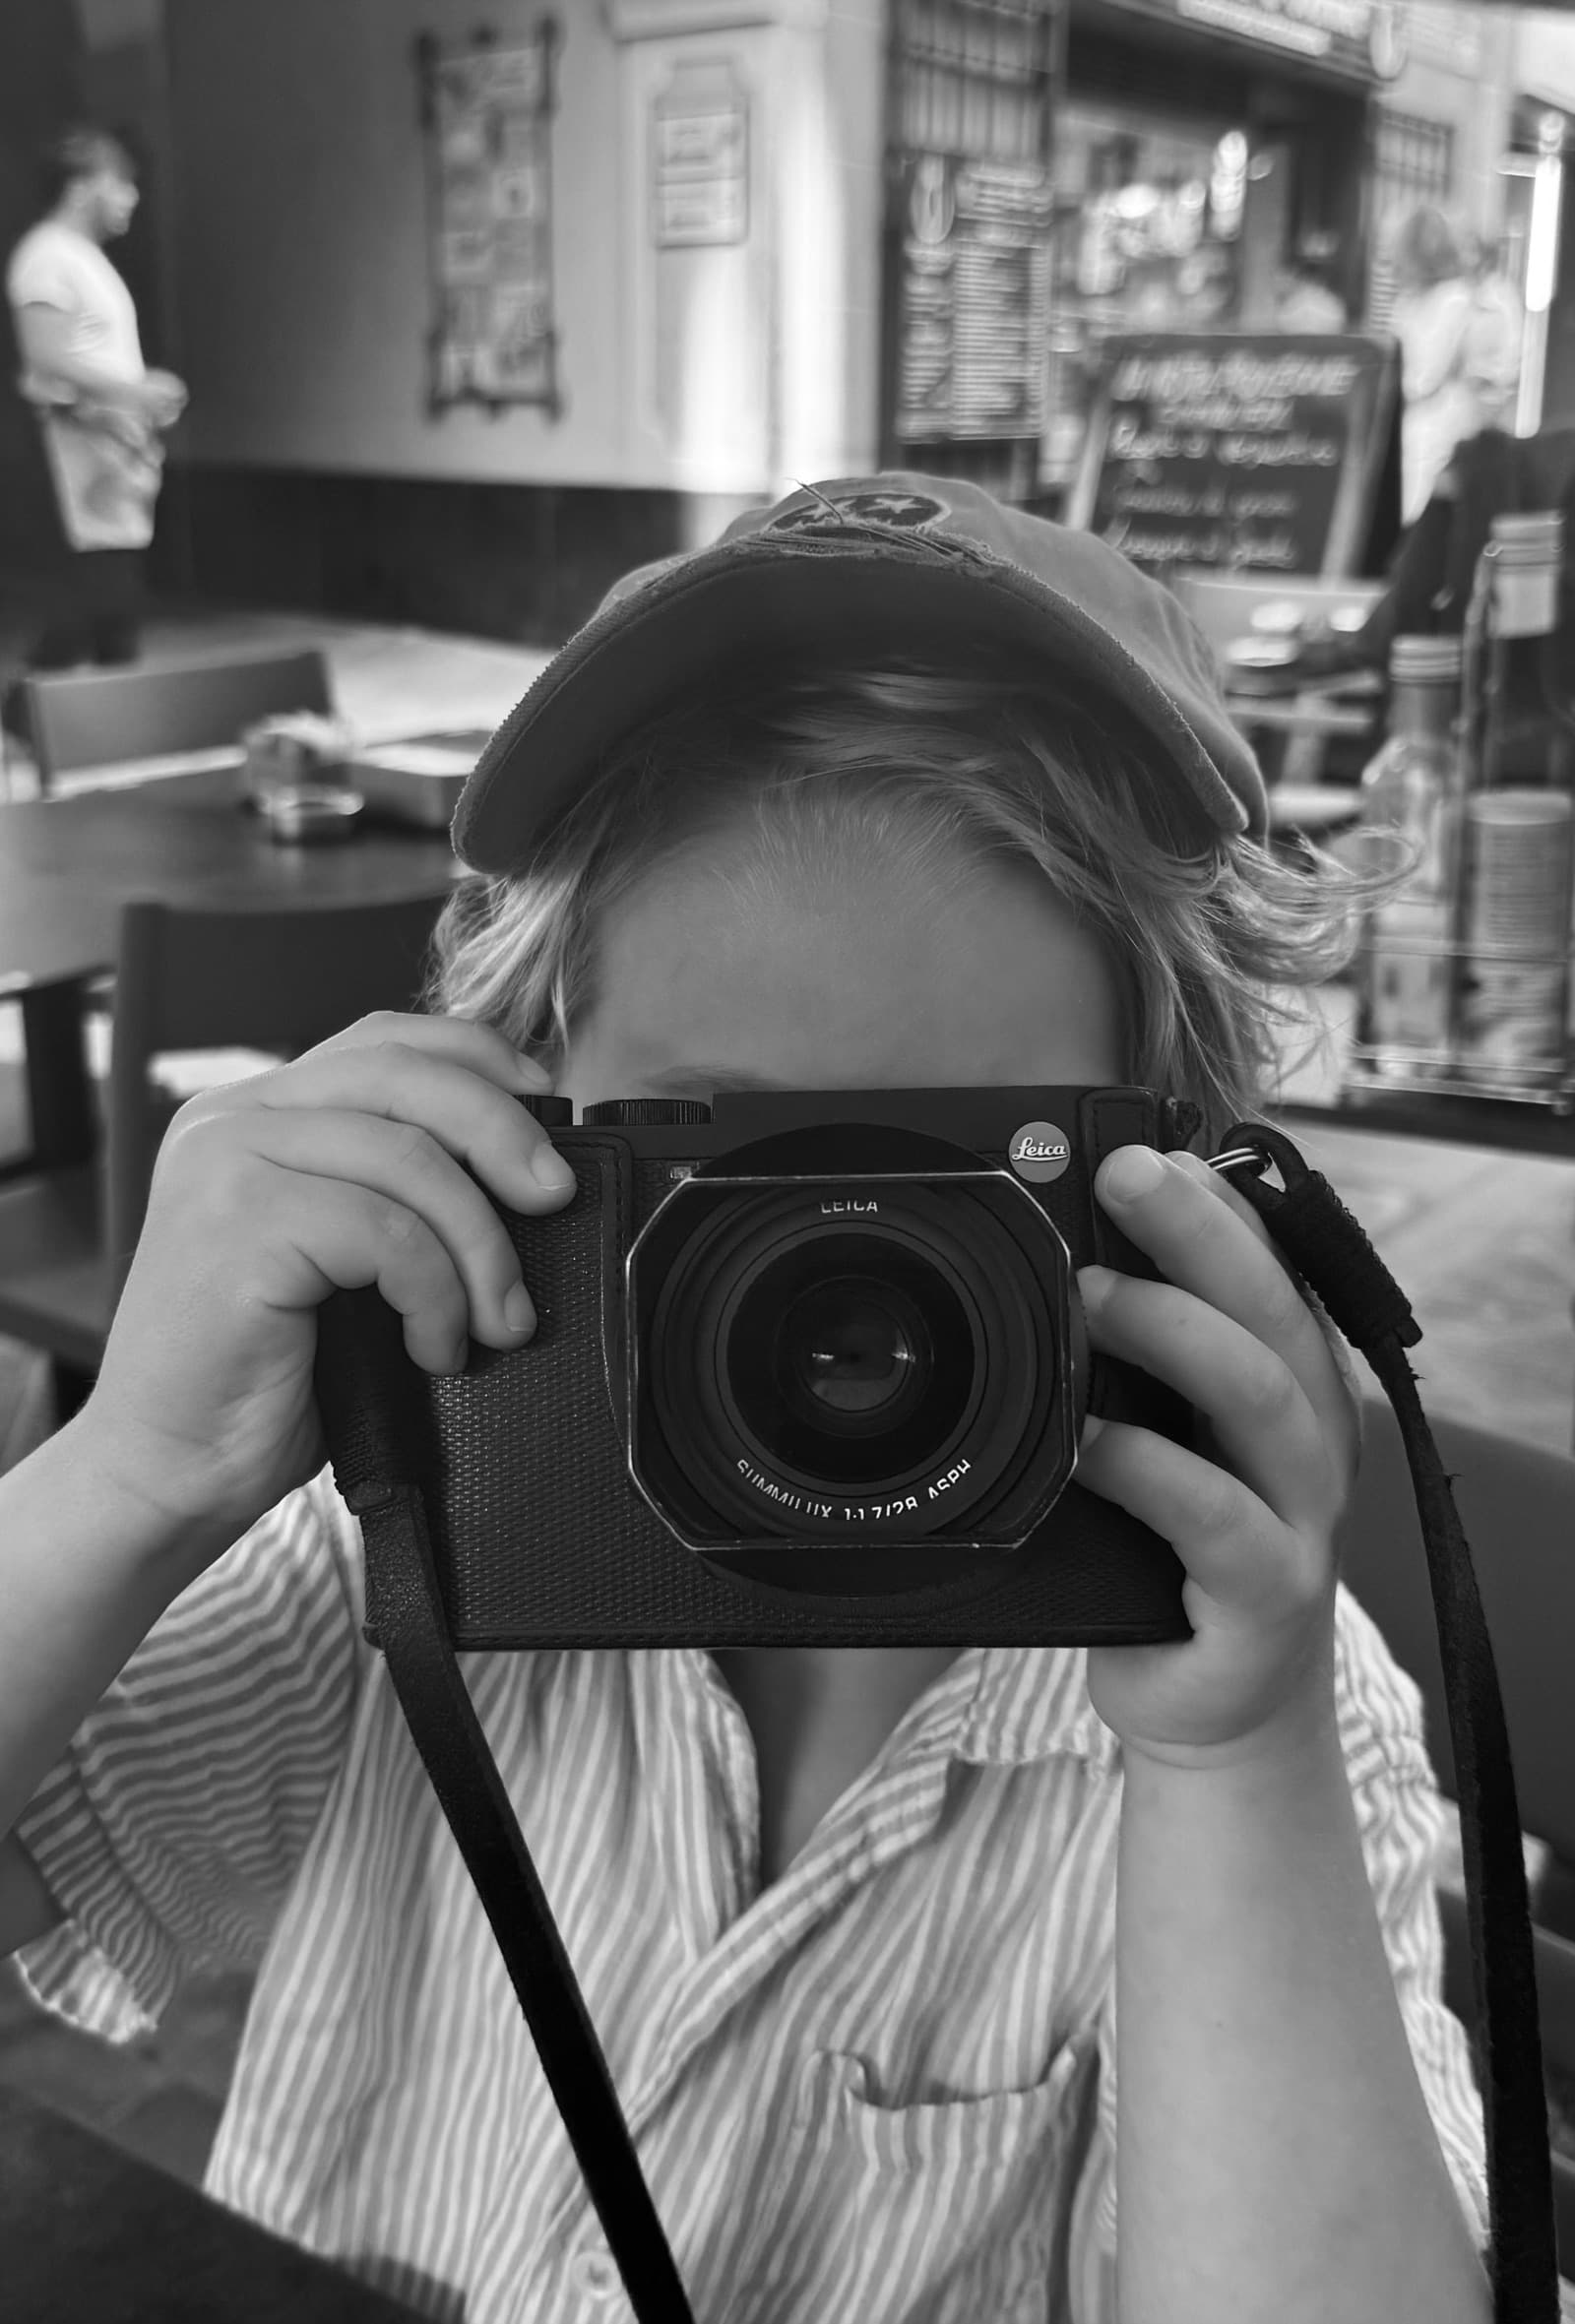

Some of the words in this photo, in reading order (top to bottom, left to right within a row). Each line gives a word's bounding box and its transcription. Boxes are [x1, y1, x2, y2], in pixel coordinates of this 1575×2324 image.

[1012, 1136, 1067, 1162] Leica
[821, 1200, 878, 1214] LEICA
[927, 1458, 972, 1499] ASPH
